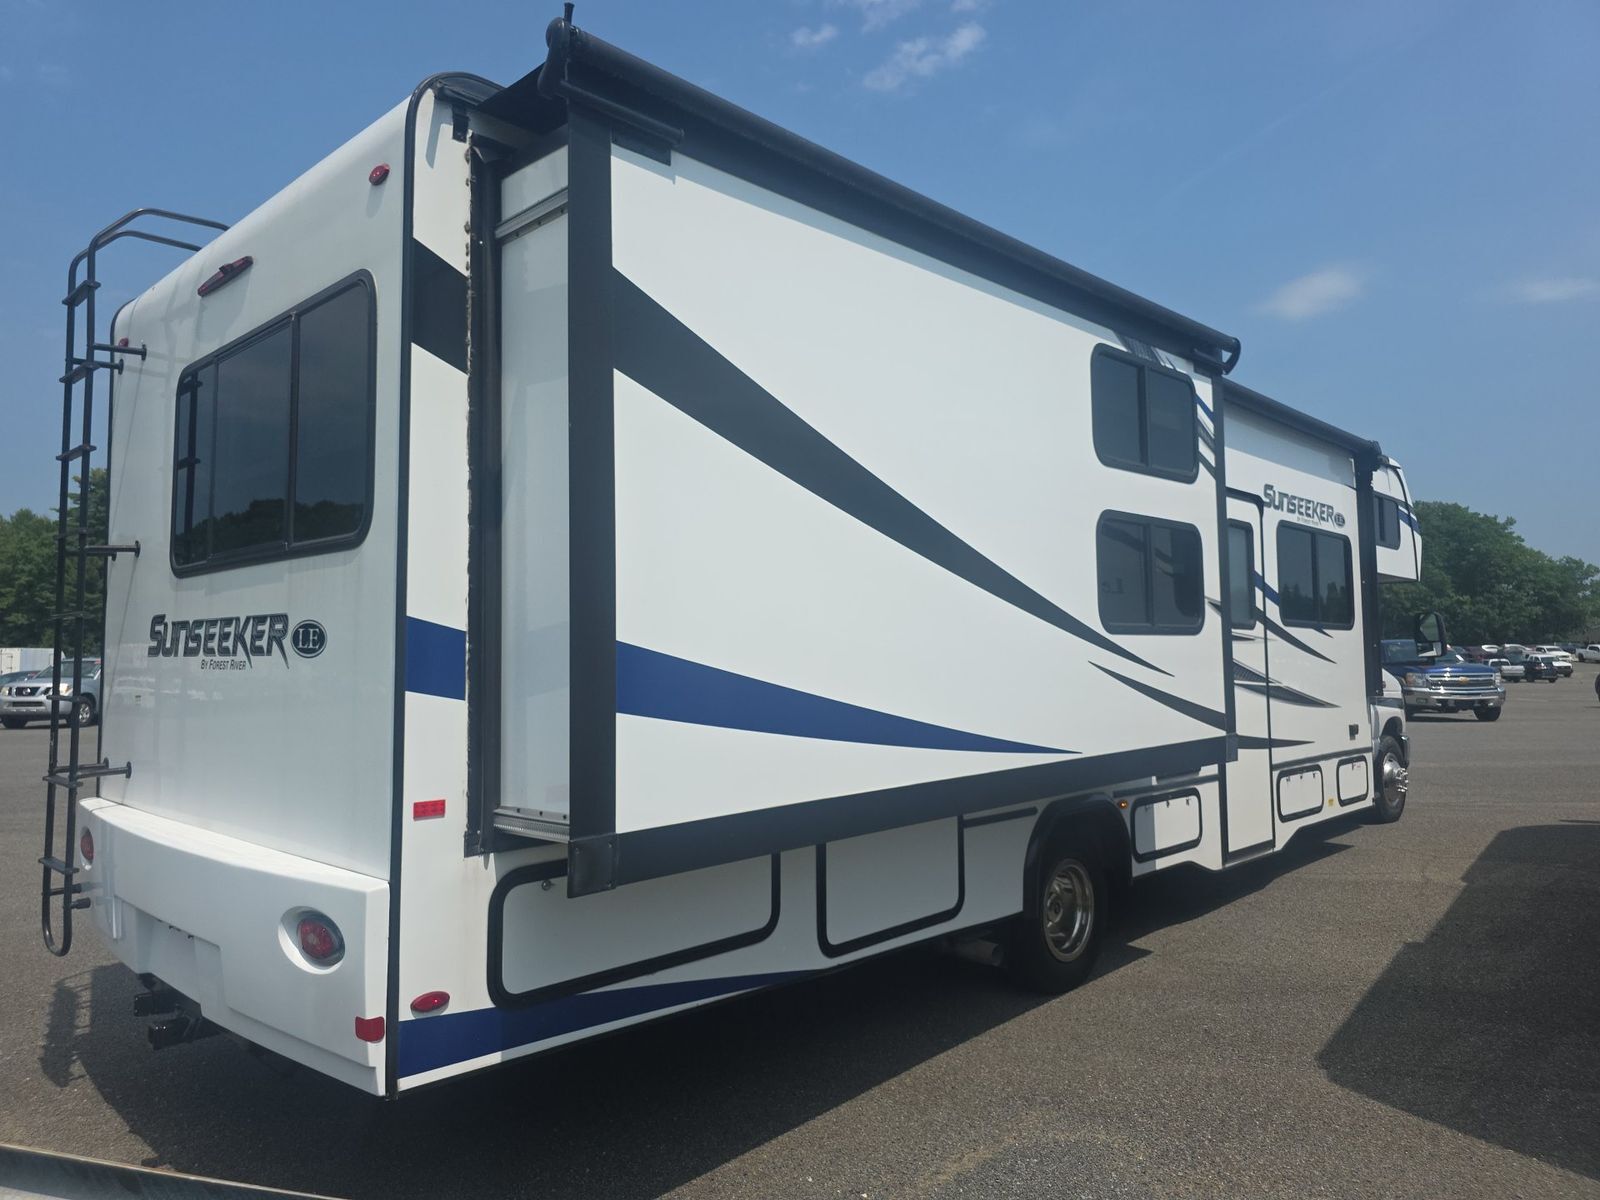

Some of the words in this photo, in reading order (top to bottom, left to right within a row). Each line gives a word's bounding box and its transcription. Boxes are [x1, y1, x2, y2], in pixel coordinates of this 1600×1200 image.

[1263, 483, 1336, 529] SUNSEEKER
[147, 612, 290, 669] SUNSEEKER
[297, 627, 321, 650] LE
[209, 659, 230, 670] FOREST
[230, 659, 247, 670] RIVER
